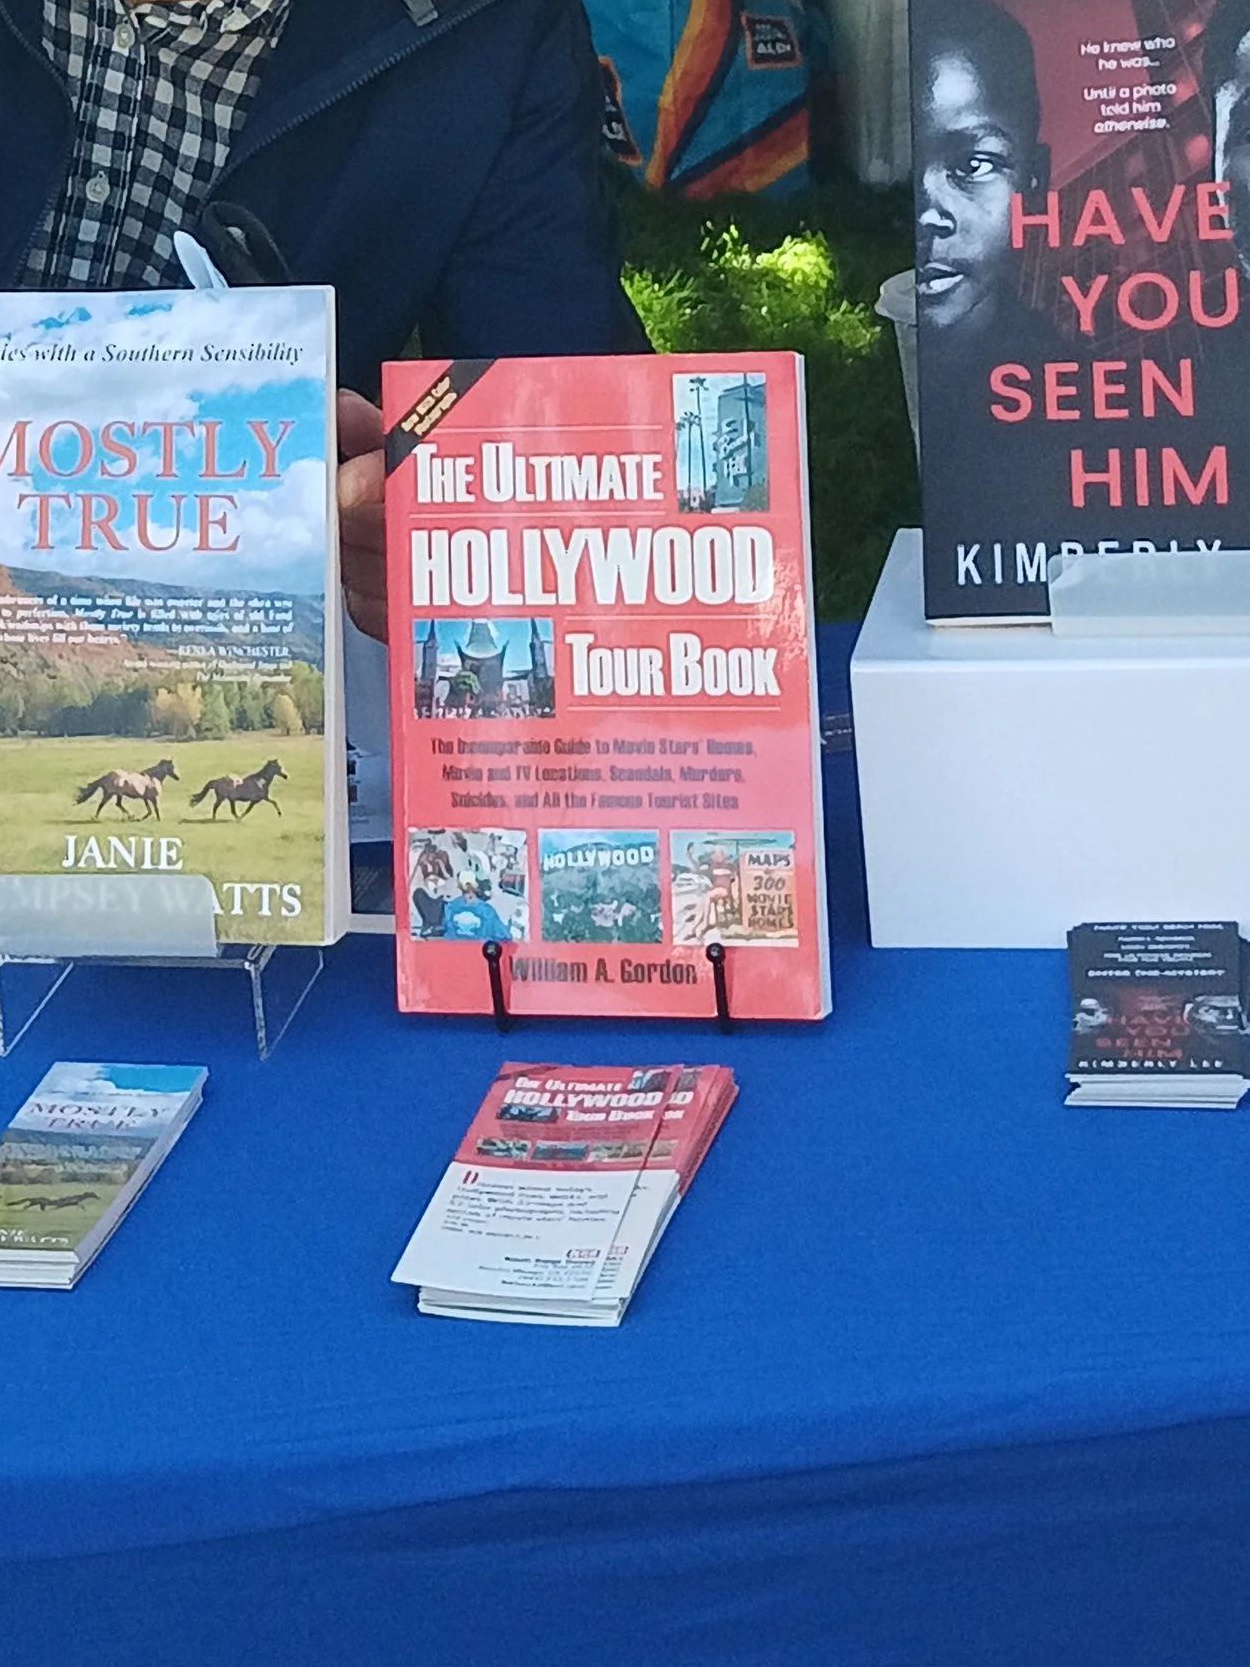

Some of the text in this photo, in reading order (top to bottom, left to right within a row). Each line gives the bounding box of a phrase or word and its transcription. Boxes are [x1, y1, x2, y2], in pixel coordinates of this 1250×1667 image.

[1144, 37, 1175, 50] who
[1119, 87, 1130, 98] a
[1132, 83, 1177, 100] photo
[1132, 100, 1162, 114] him
[1010, 181, 1234, 249] HAVE
[1061, 267, 1239, 332] YOU
[34, 342, 77, 362] with
[83, 347, 96, 362] a
[101, 343, 193, 362] Southern
[200, 342, 304, 365] Sensibility
[989, 358, 1195, 423] SEEN
[1070, 446, 1229, 508] HIM
[17, 493, 241, 553] TRUE
[410, 525, 776, 607] HOLLYWOOD
[565, 632, 781, 697] TOUR BOOK
[431, 738, 454, 755] The
[554, 737, 591, 754] Guide
[597, 738, 610, 754] to
[613, 738, 655, 755] Movie
[442, 765, 483, 781] Movie
[487, 765, 511, 781] and
[516, 765, 532, 781] TV
[514, 791, 539, 809] and
[542, 791, 561, 808] All
[564, 791, 587, 809] the
[590, 791, 643, 809] Famous
[647, 791, 699, 809] Tourist
[702, 791, 739, 809] Sites
[62, 835, 184, 870] JANIE
[542, 845, 791, 872] HOLLYWOOD MAPS
[753, 875, 786, 891] 300
[510, 957, 698, 985] William A. Gordon
[30, 1102, 170, 1119] MOSTLY
[504, 1089, 664, 1108] HOLLYWOOD
